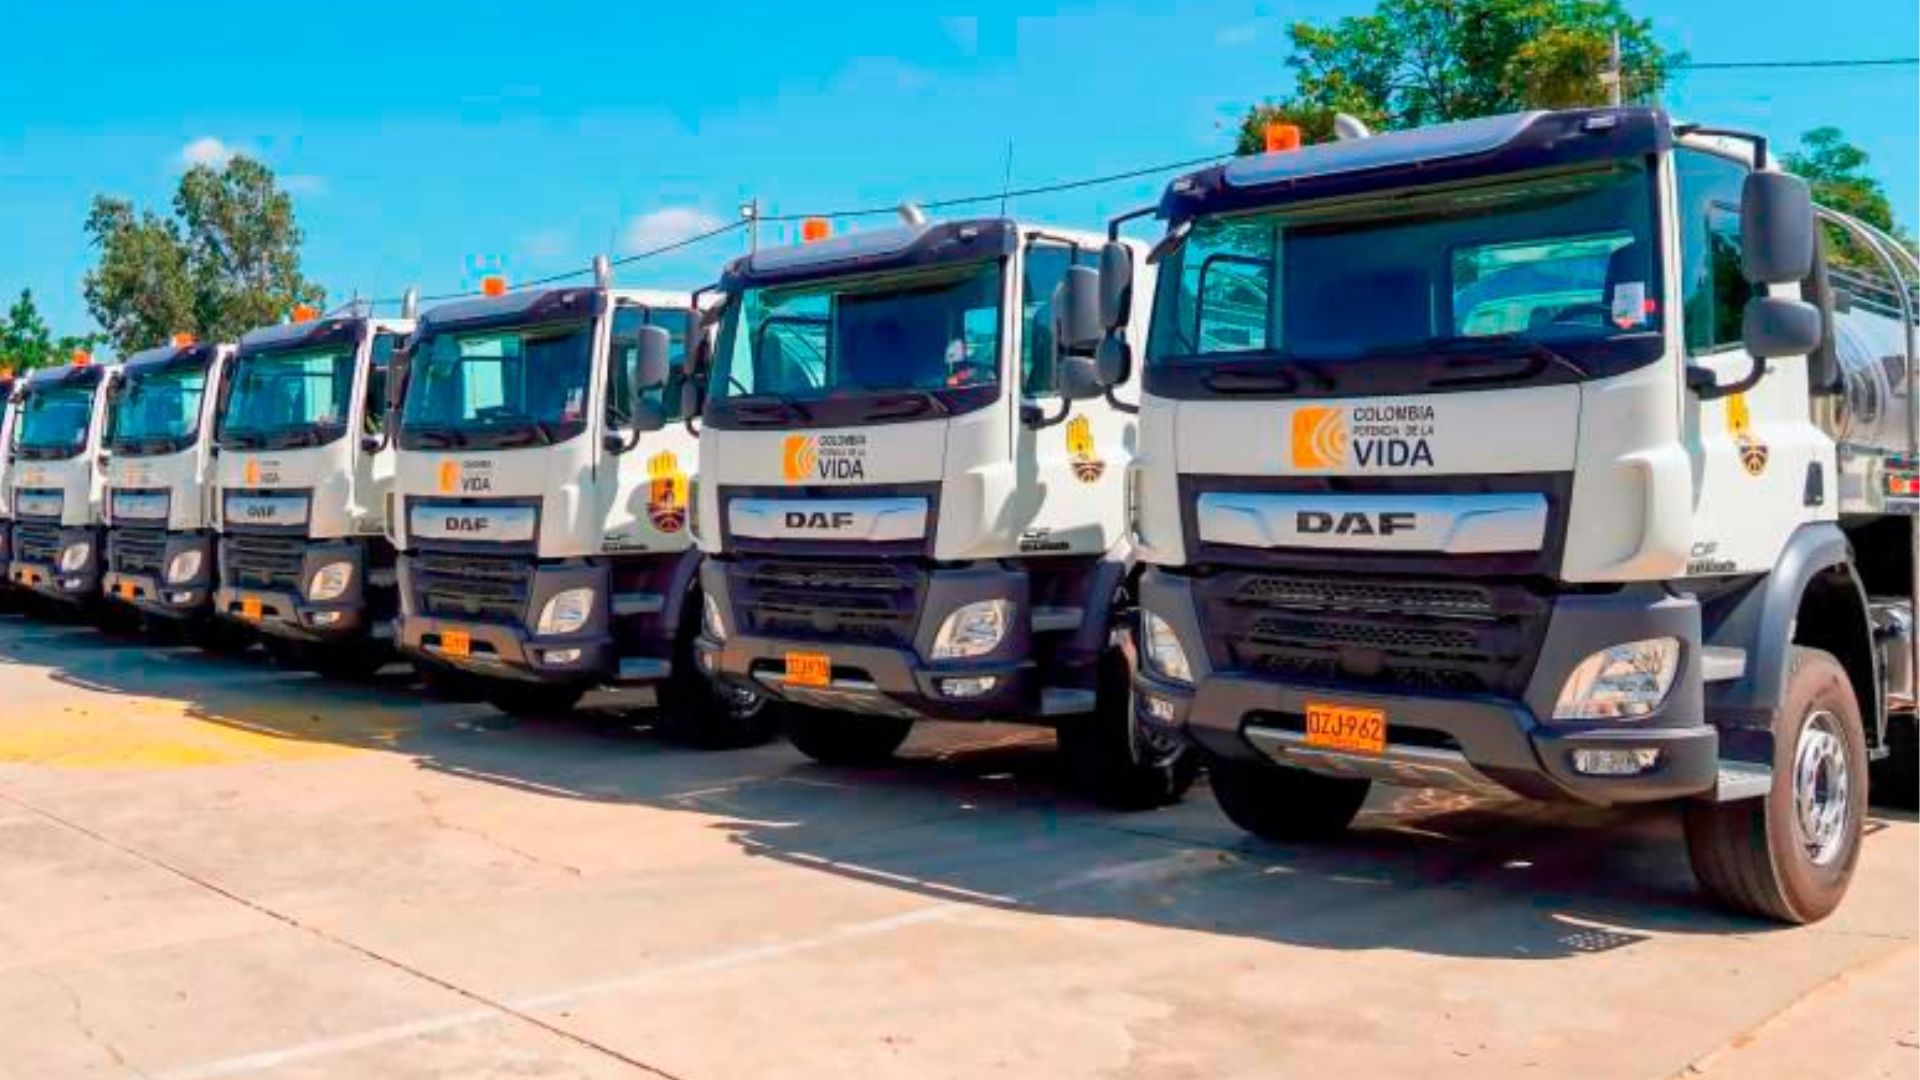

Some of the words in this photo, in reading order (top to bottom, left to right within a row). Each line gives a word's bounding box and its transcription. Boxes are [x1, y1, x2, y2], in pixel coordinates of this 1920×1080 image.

[1353, 405, 1434, 421] COLOMBIA
[1421, 425, 1434, 436] LA
[1353, 438, 1434, 466] VIDA
[819, 458, 864, 479] VIDA
[446, 517, 489, 532] DAF
[785, 512, 854, 529] DAF
[1297, 511, 1415, 535] DAF
